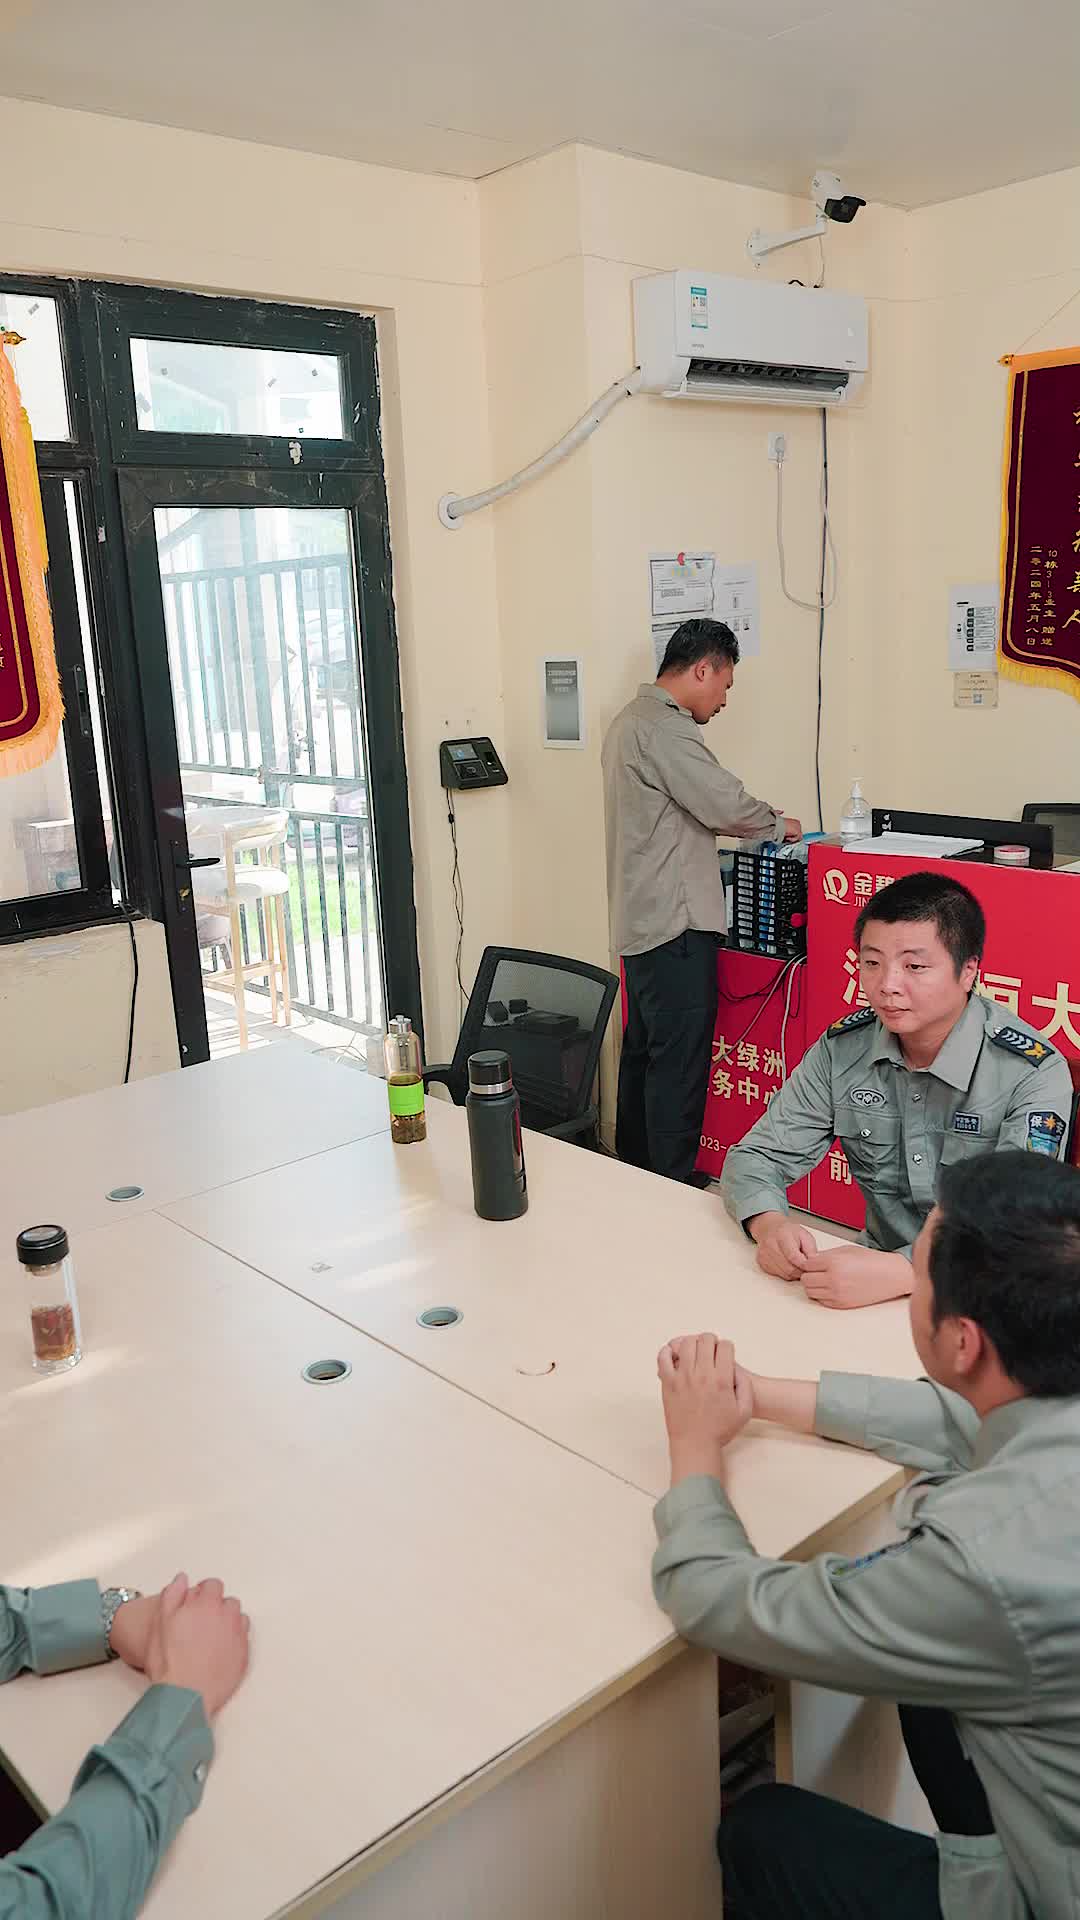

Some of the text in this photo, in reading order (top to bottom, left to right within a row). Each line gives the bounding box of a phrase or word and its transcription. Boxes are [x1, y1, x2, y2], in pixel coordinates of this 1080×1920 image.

[711, 1035, 784, 1078] 大绿洲
[828, 1150, 852, 1185] 前
